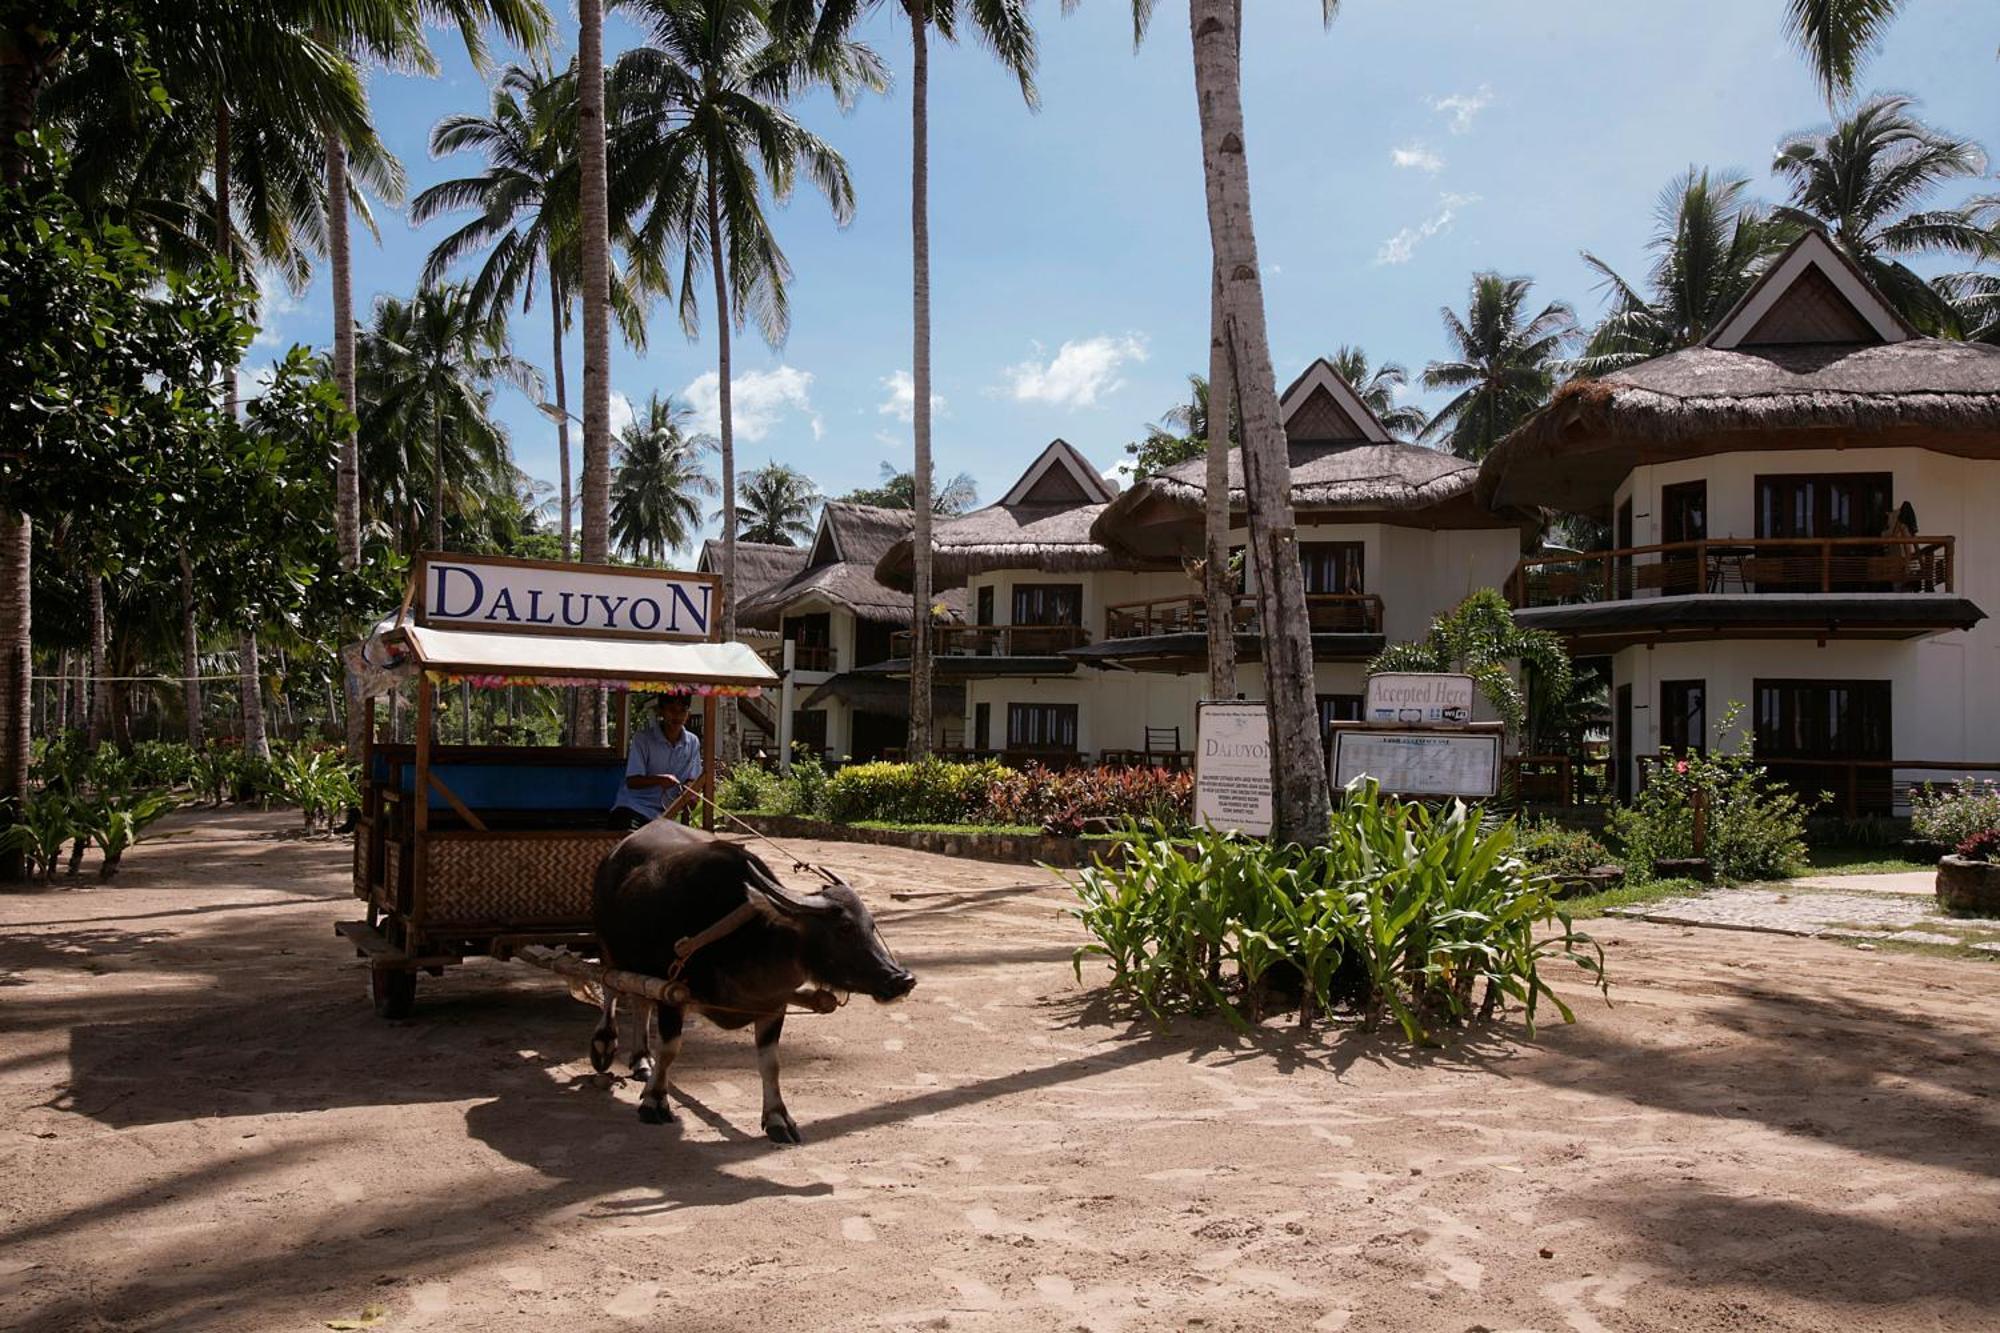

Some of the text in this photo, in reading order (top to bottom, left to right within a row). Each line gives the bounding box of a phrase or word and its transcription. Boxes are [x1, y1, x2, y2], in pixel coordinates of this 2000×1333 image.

[428, 565, 713, 634] DALUYON
[1375, 682, 1468, 707] Accepted Here
